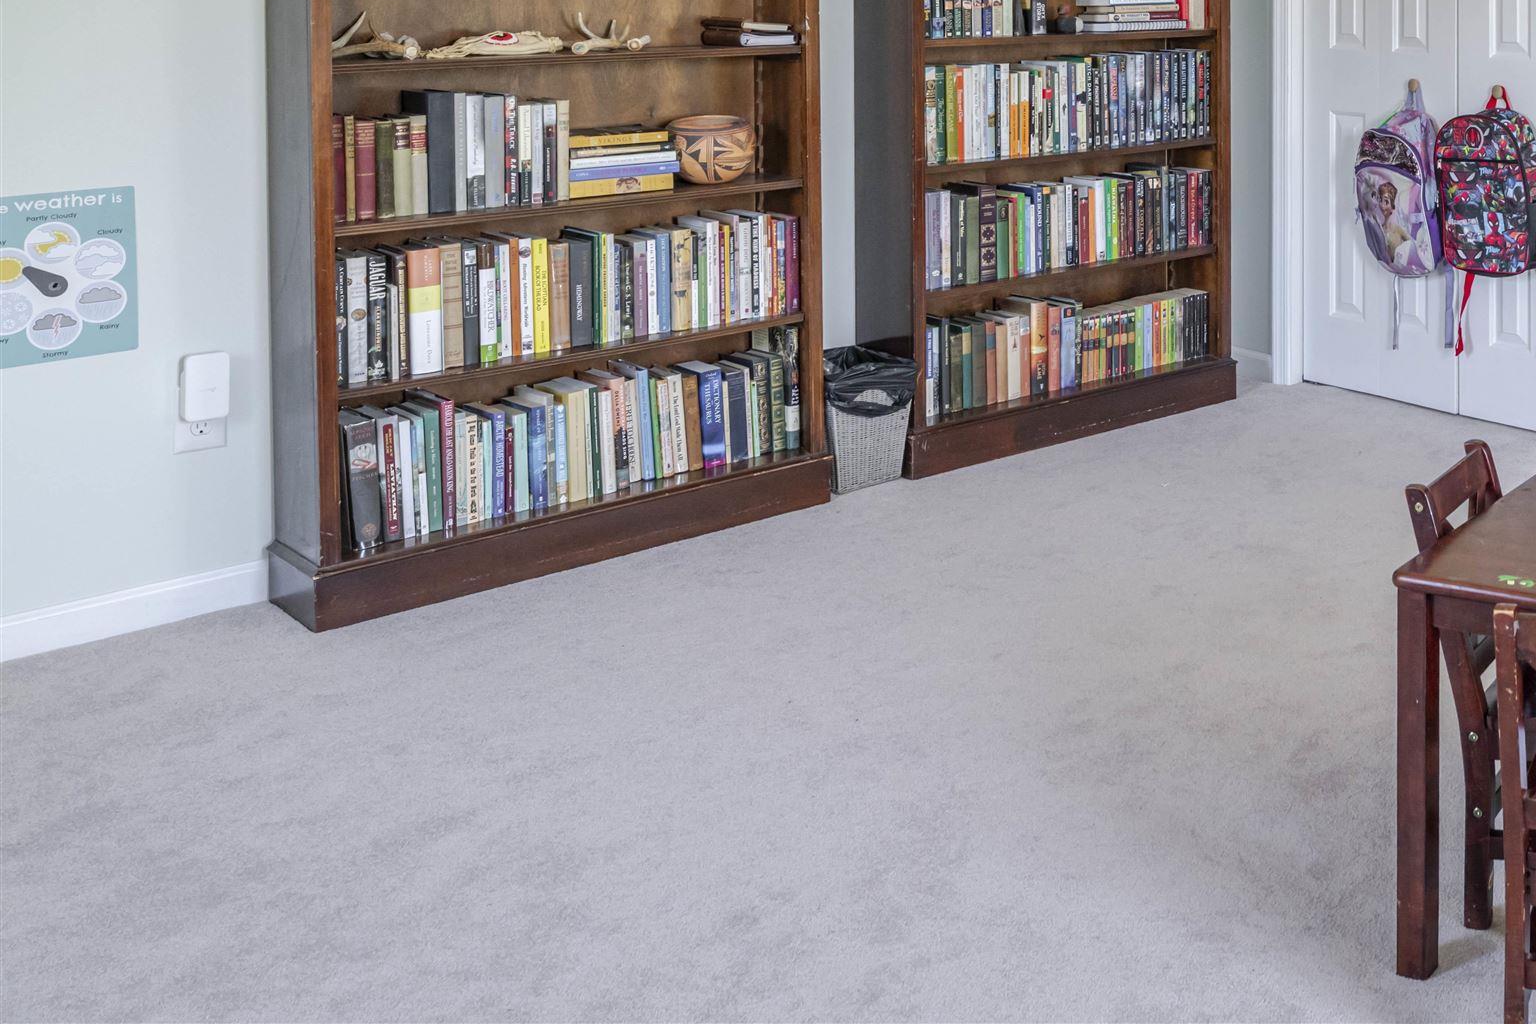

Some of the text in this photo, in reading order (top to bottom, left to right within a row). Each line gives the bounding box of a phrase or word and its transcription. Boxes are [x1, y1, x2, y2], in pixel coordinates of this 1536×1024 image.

[15, 193, 106, 211] weather
[112, 194, 122, 203] is
[369, 261, 386, 300] JAGUAR
[713, 380, 721, 424] DICTIONARY
